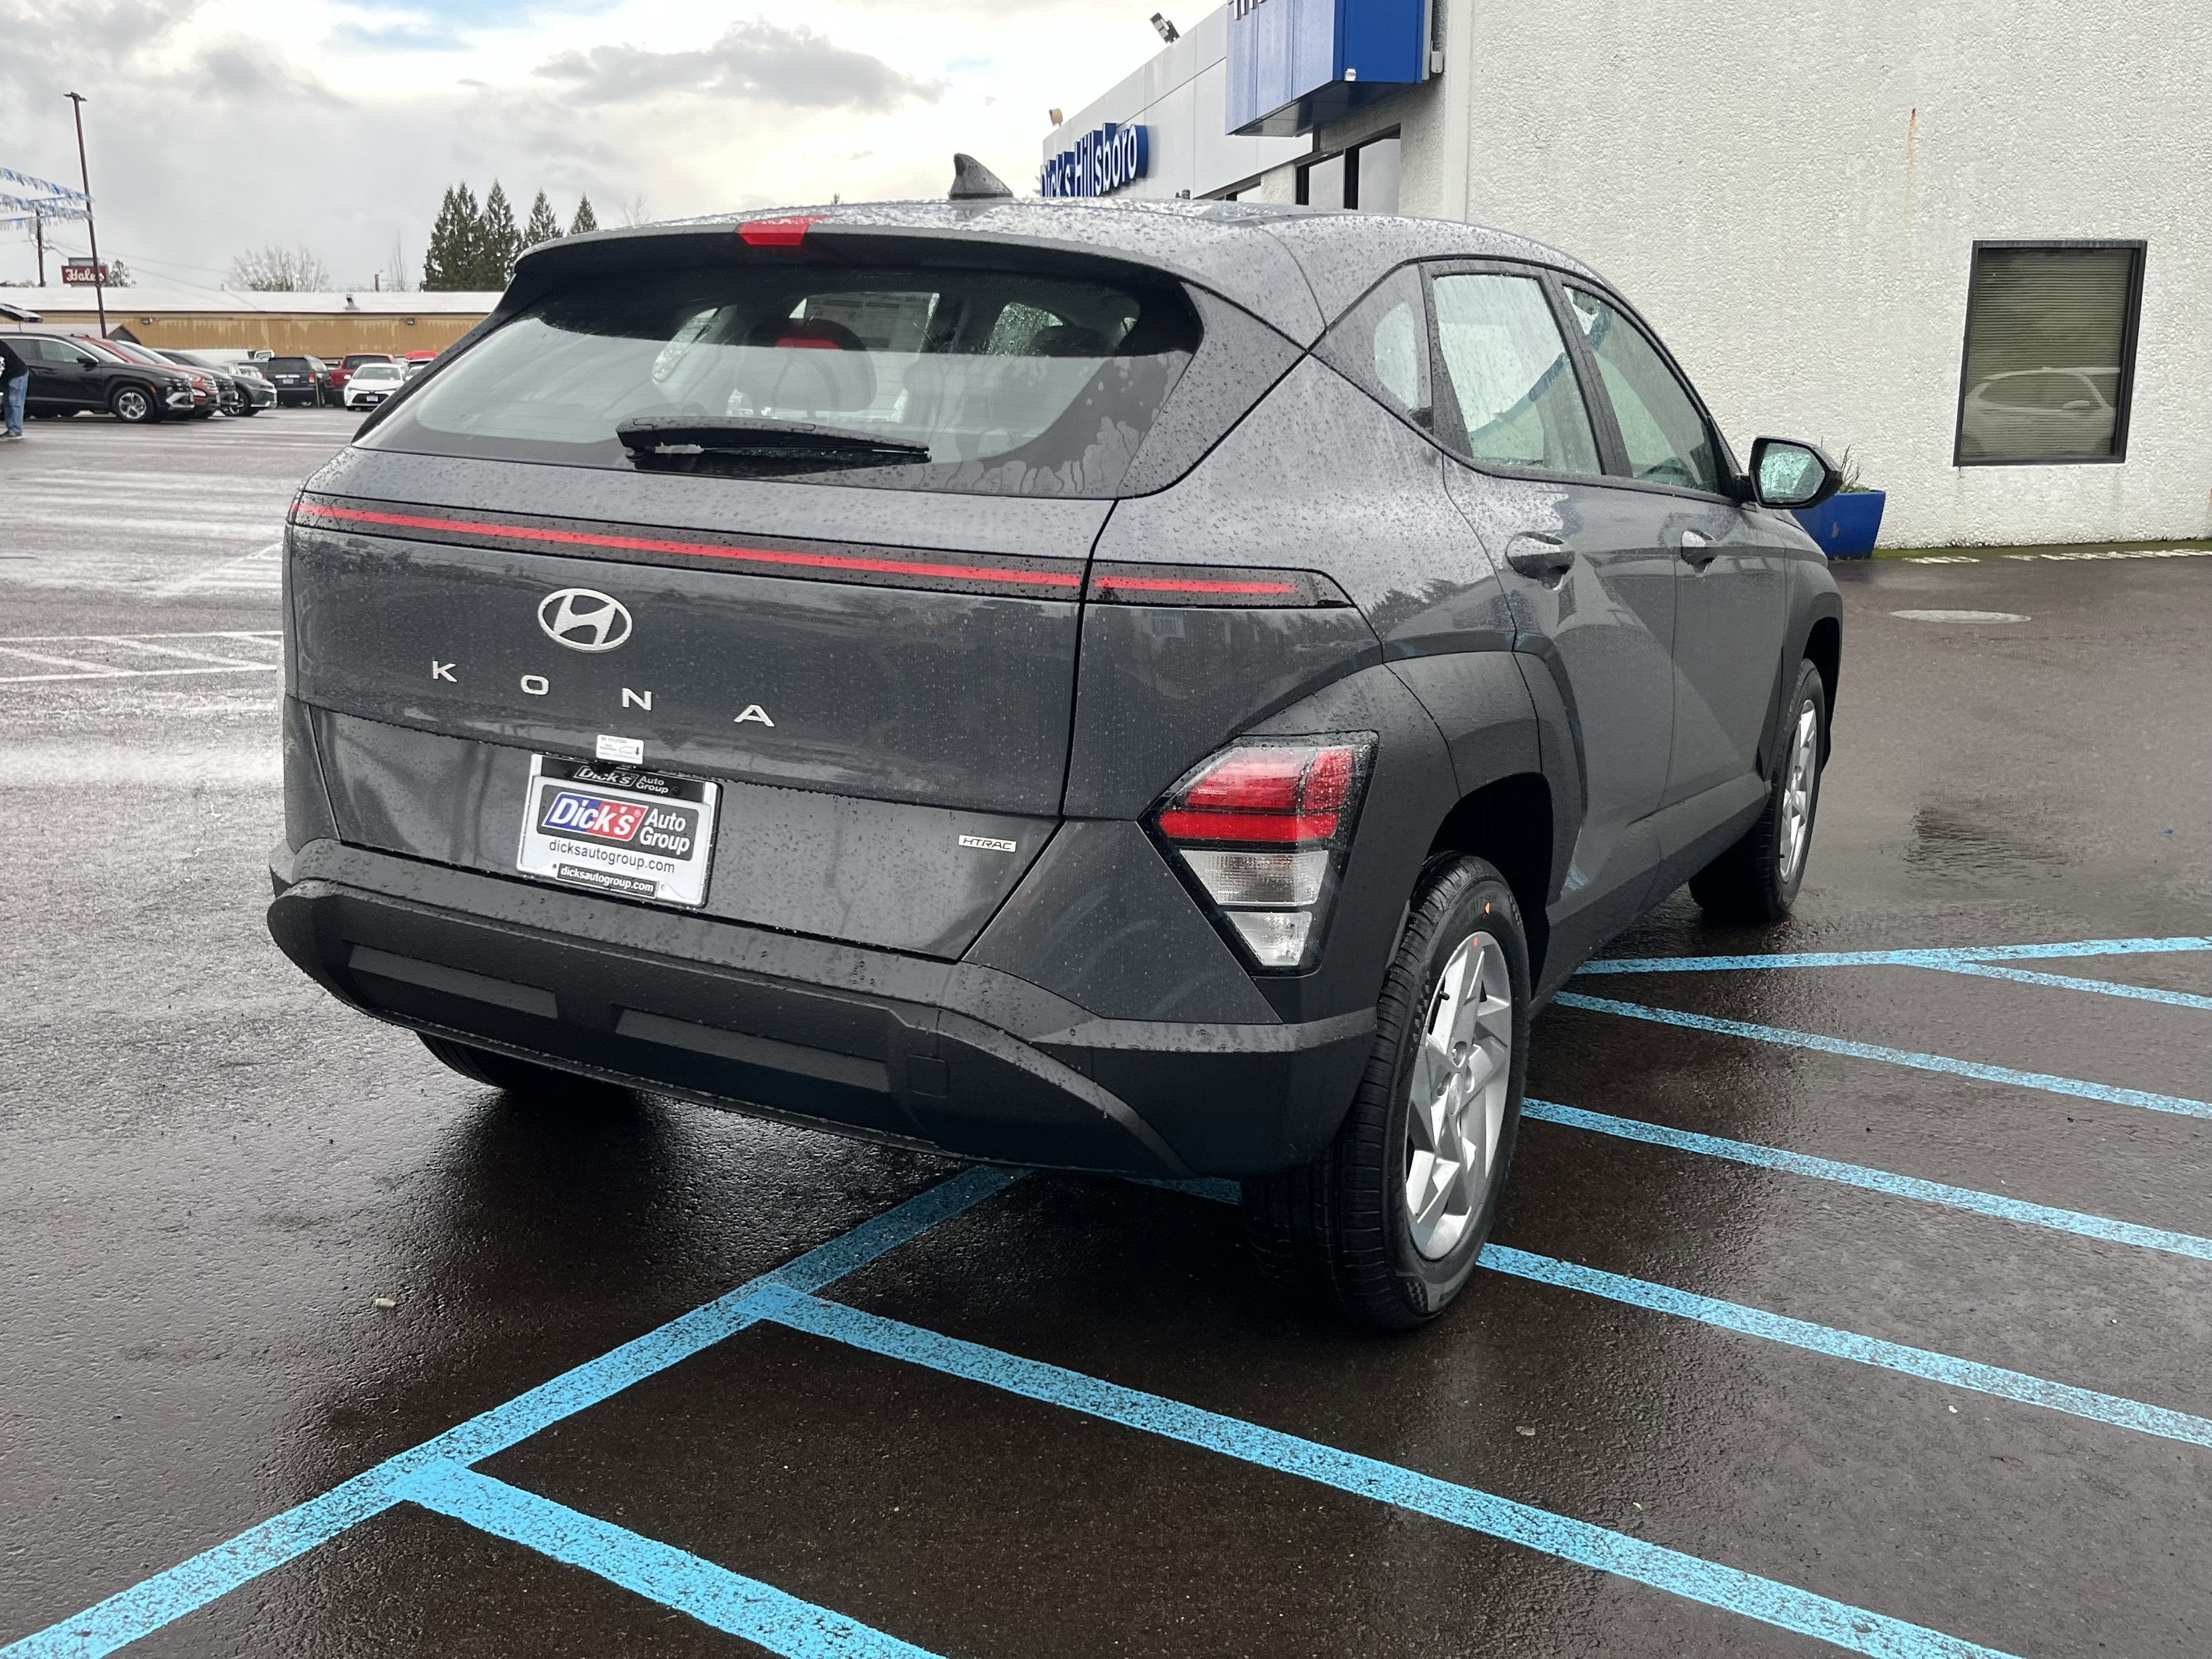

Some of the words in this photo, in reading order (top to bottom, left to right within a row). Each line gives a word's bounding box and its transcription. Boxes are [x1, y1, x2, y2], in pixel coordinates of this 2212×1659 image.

[1075, 124, 1138, 198] Hillsboro
[432, 661, 775, 727] KONA
[635, 781, 669, 794] Group
[639, 775, 665, 786] Auto
[550, 797, 635, 837] Dick's
[645, 808, 686, 832] Auto
[640, 826, 690, 855] Group
[963, 837, 1012, 849] HTRAC
[549, 839, 675, 873] dicksautogroup.com
[560, 866, 654, 893] dicksautogroup.com
